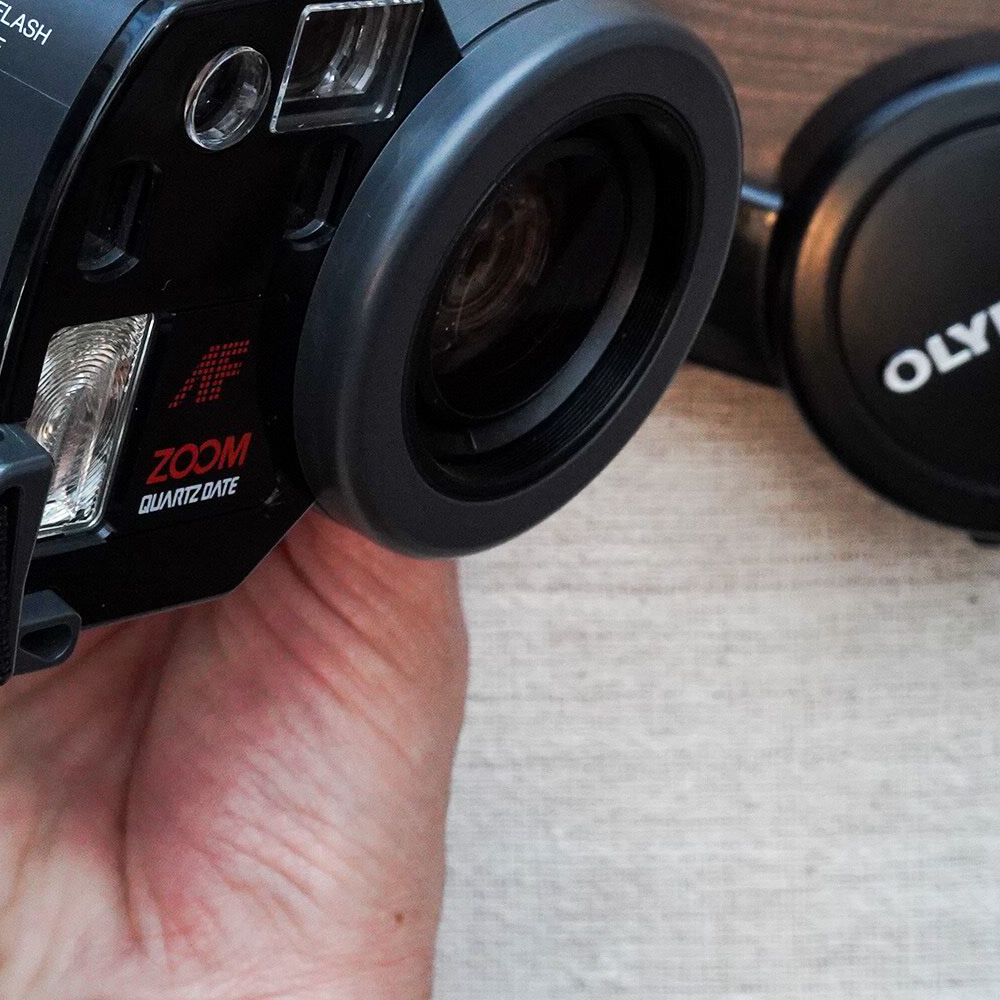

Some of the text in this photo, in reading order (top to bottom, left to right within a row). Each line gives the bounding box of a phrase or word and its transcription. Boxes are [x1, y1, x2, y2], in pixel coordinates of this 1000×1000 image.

[167, 340, 250, 409] AF
[146, 432, 253, 485] ZOOM
[138, 476, 241, 515] QUARTZ DATE
